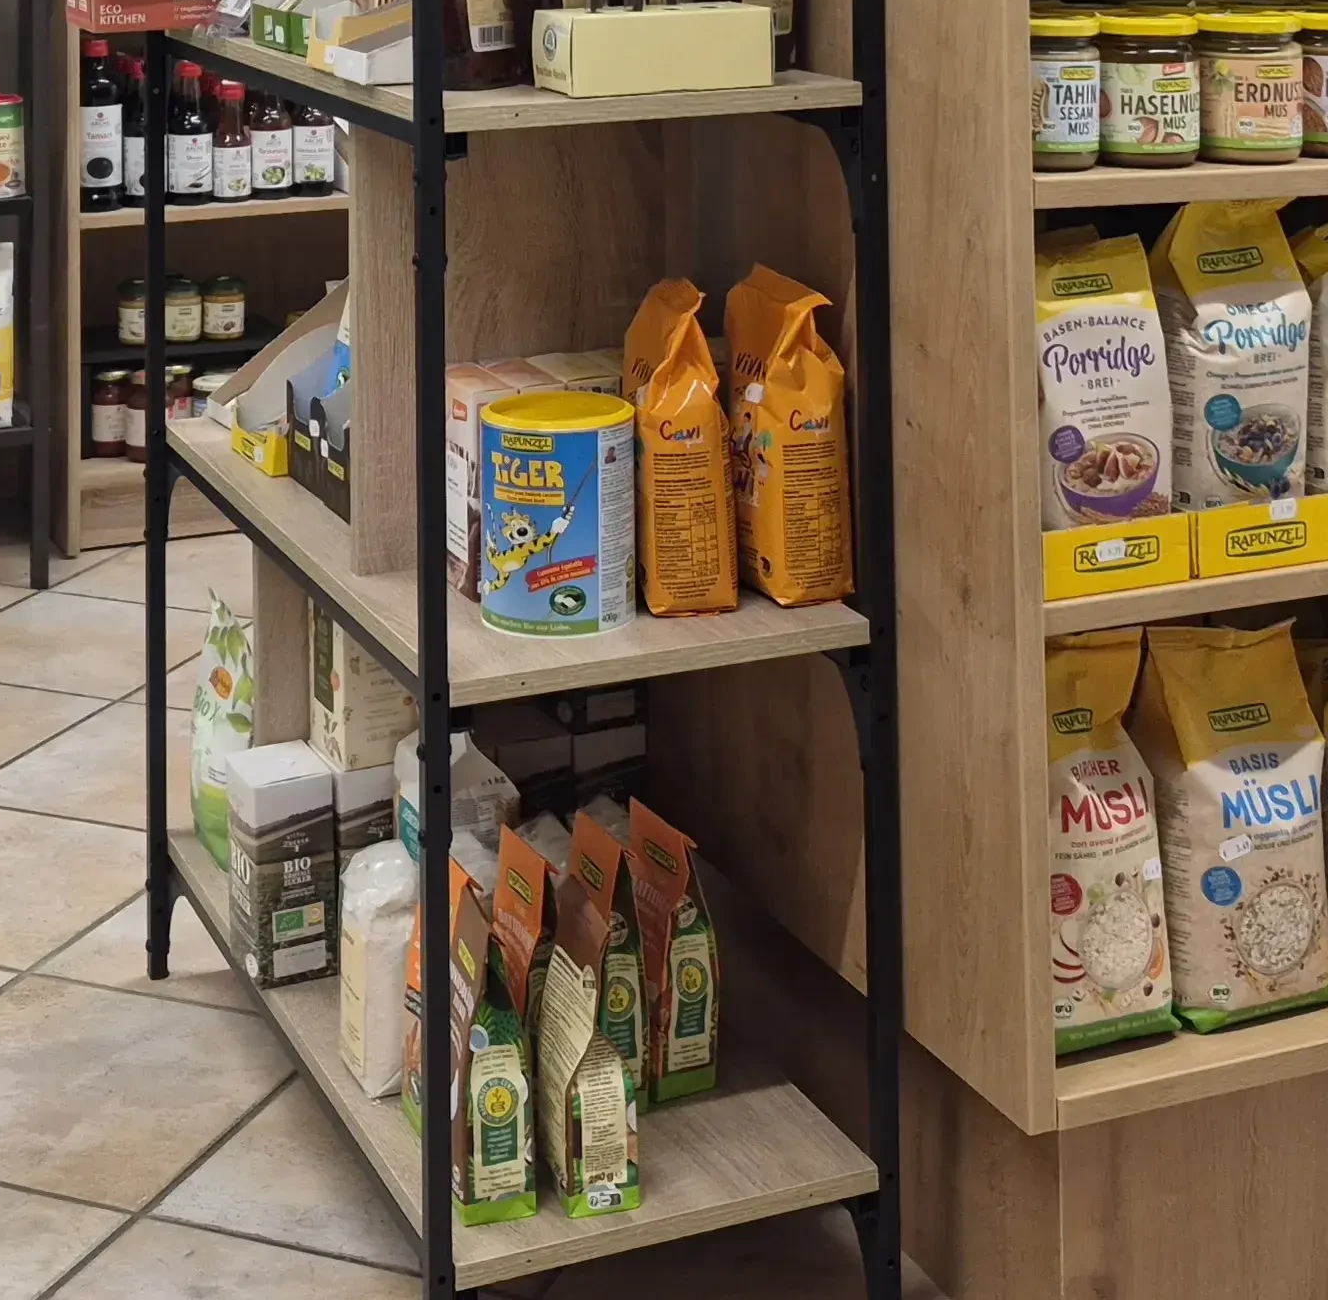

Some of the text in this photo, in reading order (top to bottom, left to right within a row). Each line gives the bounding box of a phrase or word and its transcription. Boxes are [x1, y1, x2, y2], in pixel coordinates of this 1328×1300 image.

[100, 4, 122, 14] ECO
[100, 14, 146, 25] KITCHEN
[1052, 84, 1097, 106] TAHIN
[1059, 106, 1094, 121] SESAM
[1264, 104, 1288, 118] MUS
[1068, 122, 1090, 136] MUS
[1163, 115, 1187, 130] MUS
[1200, 249, 1260, 271] RAPUNZEL
[1056, 276, 1109, 295] RAPUNZEL
[1043, 315, 1147, 344] BASEN-BALANCE
[1204, 316, 1307, 356] Porridge
[1043, 336, 1156, 384] Porridge
[1087, 377, 1114, 390] BREI
[503, 434, 551, 448] RAPUNZEL
[1229, 527, 1305, 555] RAPUNZEL
[1212, 708, 1267, 726] RAPUNZEL
[1229, 752, 1280, 775] BASIS
[1060, 776, 1151, 834] MÜSLI
[1220, 774, 1321, 829] MÜSLI
[283, 856, 312, 874] BIO
